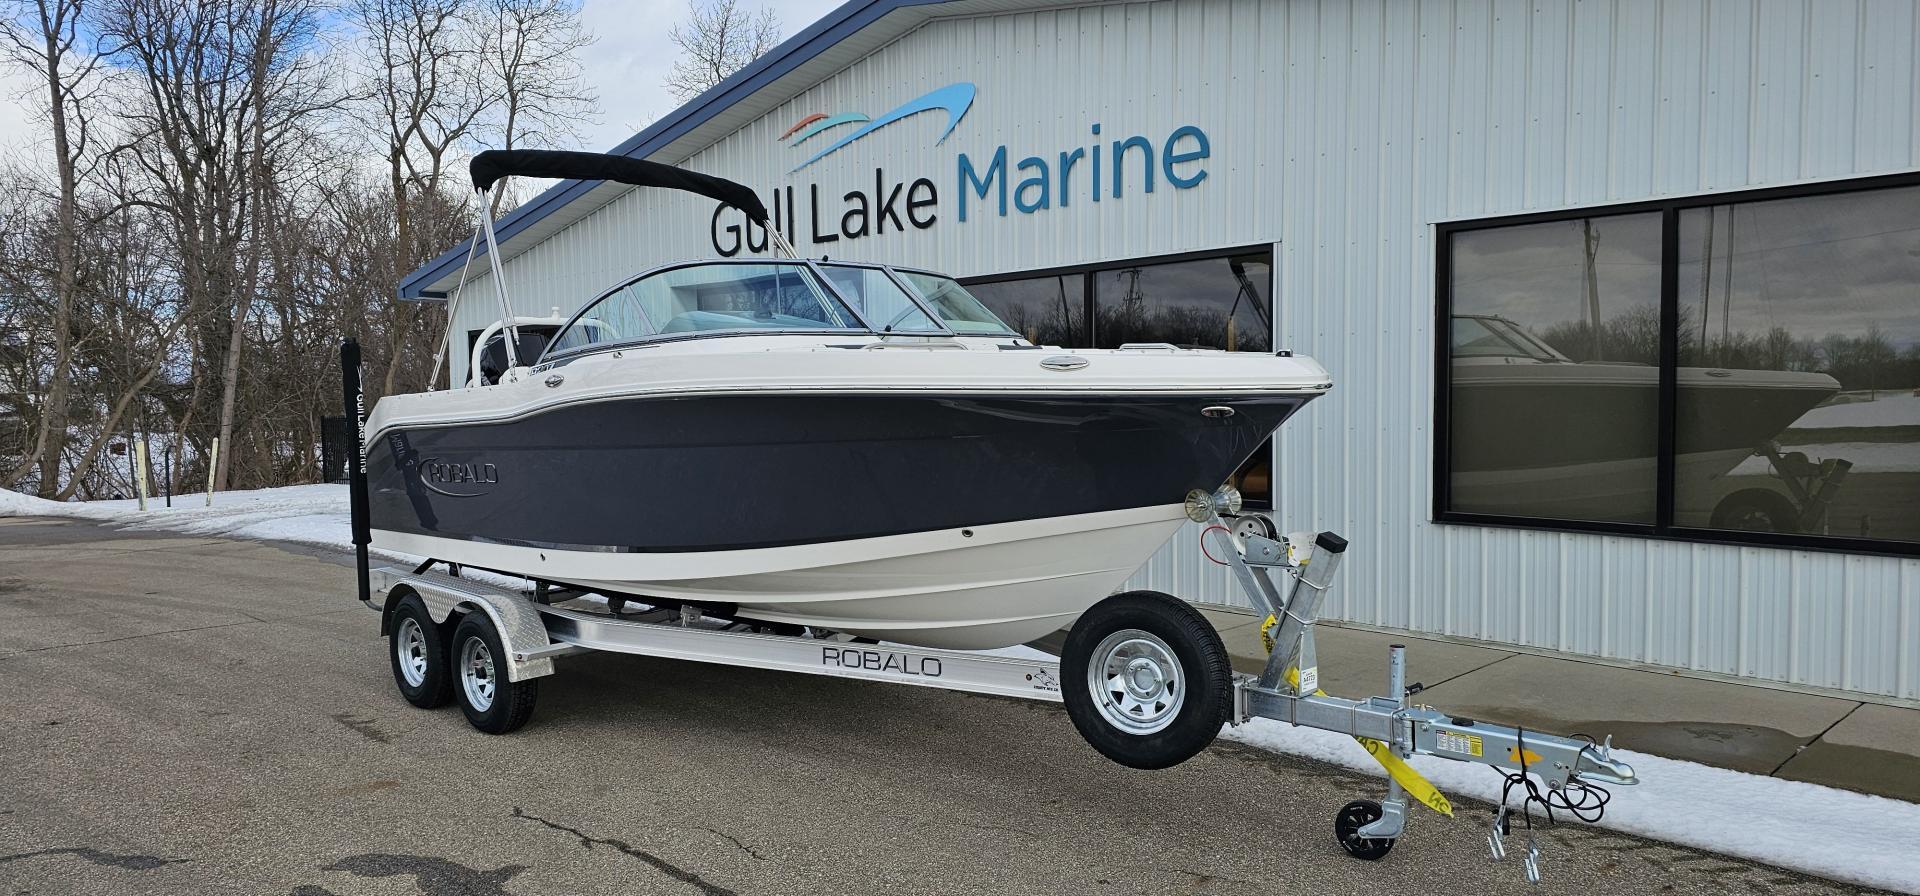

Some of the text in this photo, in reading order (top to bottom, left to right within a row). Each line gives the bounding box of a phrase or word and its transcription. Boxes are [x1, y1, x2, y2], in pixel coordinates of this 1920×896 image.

[711, 123, 1211, 257] Gull Lake Marine
[356, 393, 365, 414] Gull
[357, 415, 366, 438] Lake
[429, 462, 499, 485] ROBALO
[822, 646, 943, 677] ROBALO
